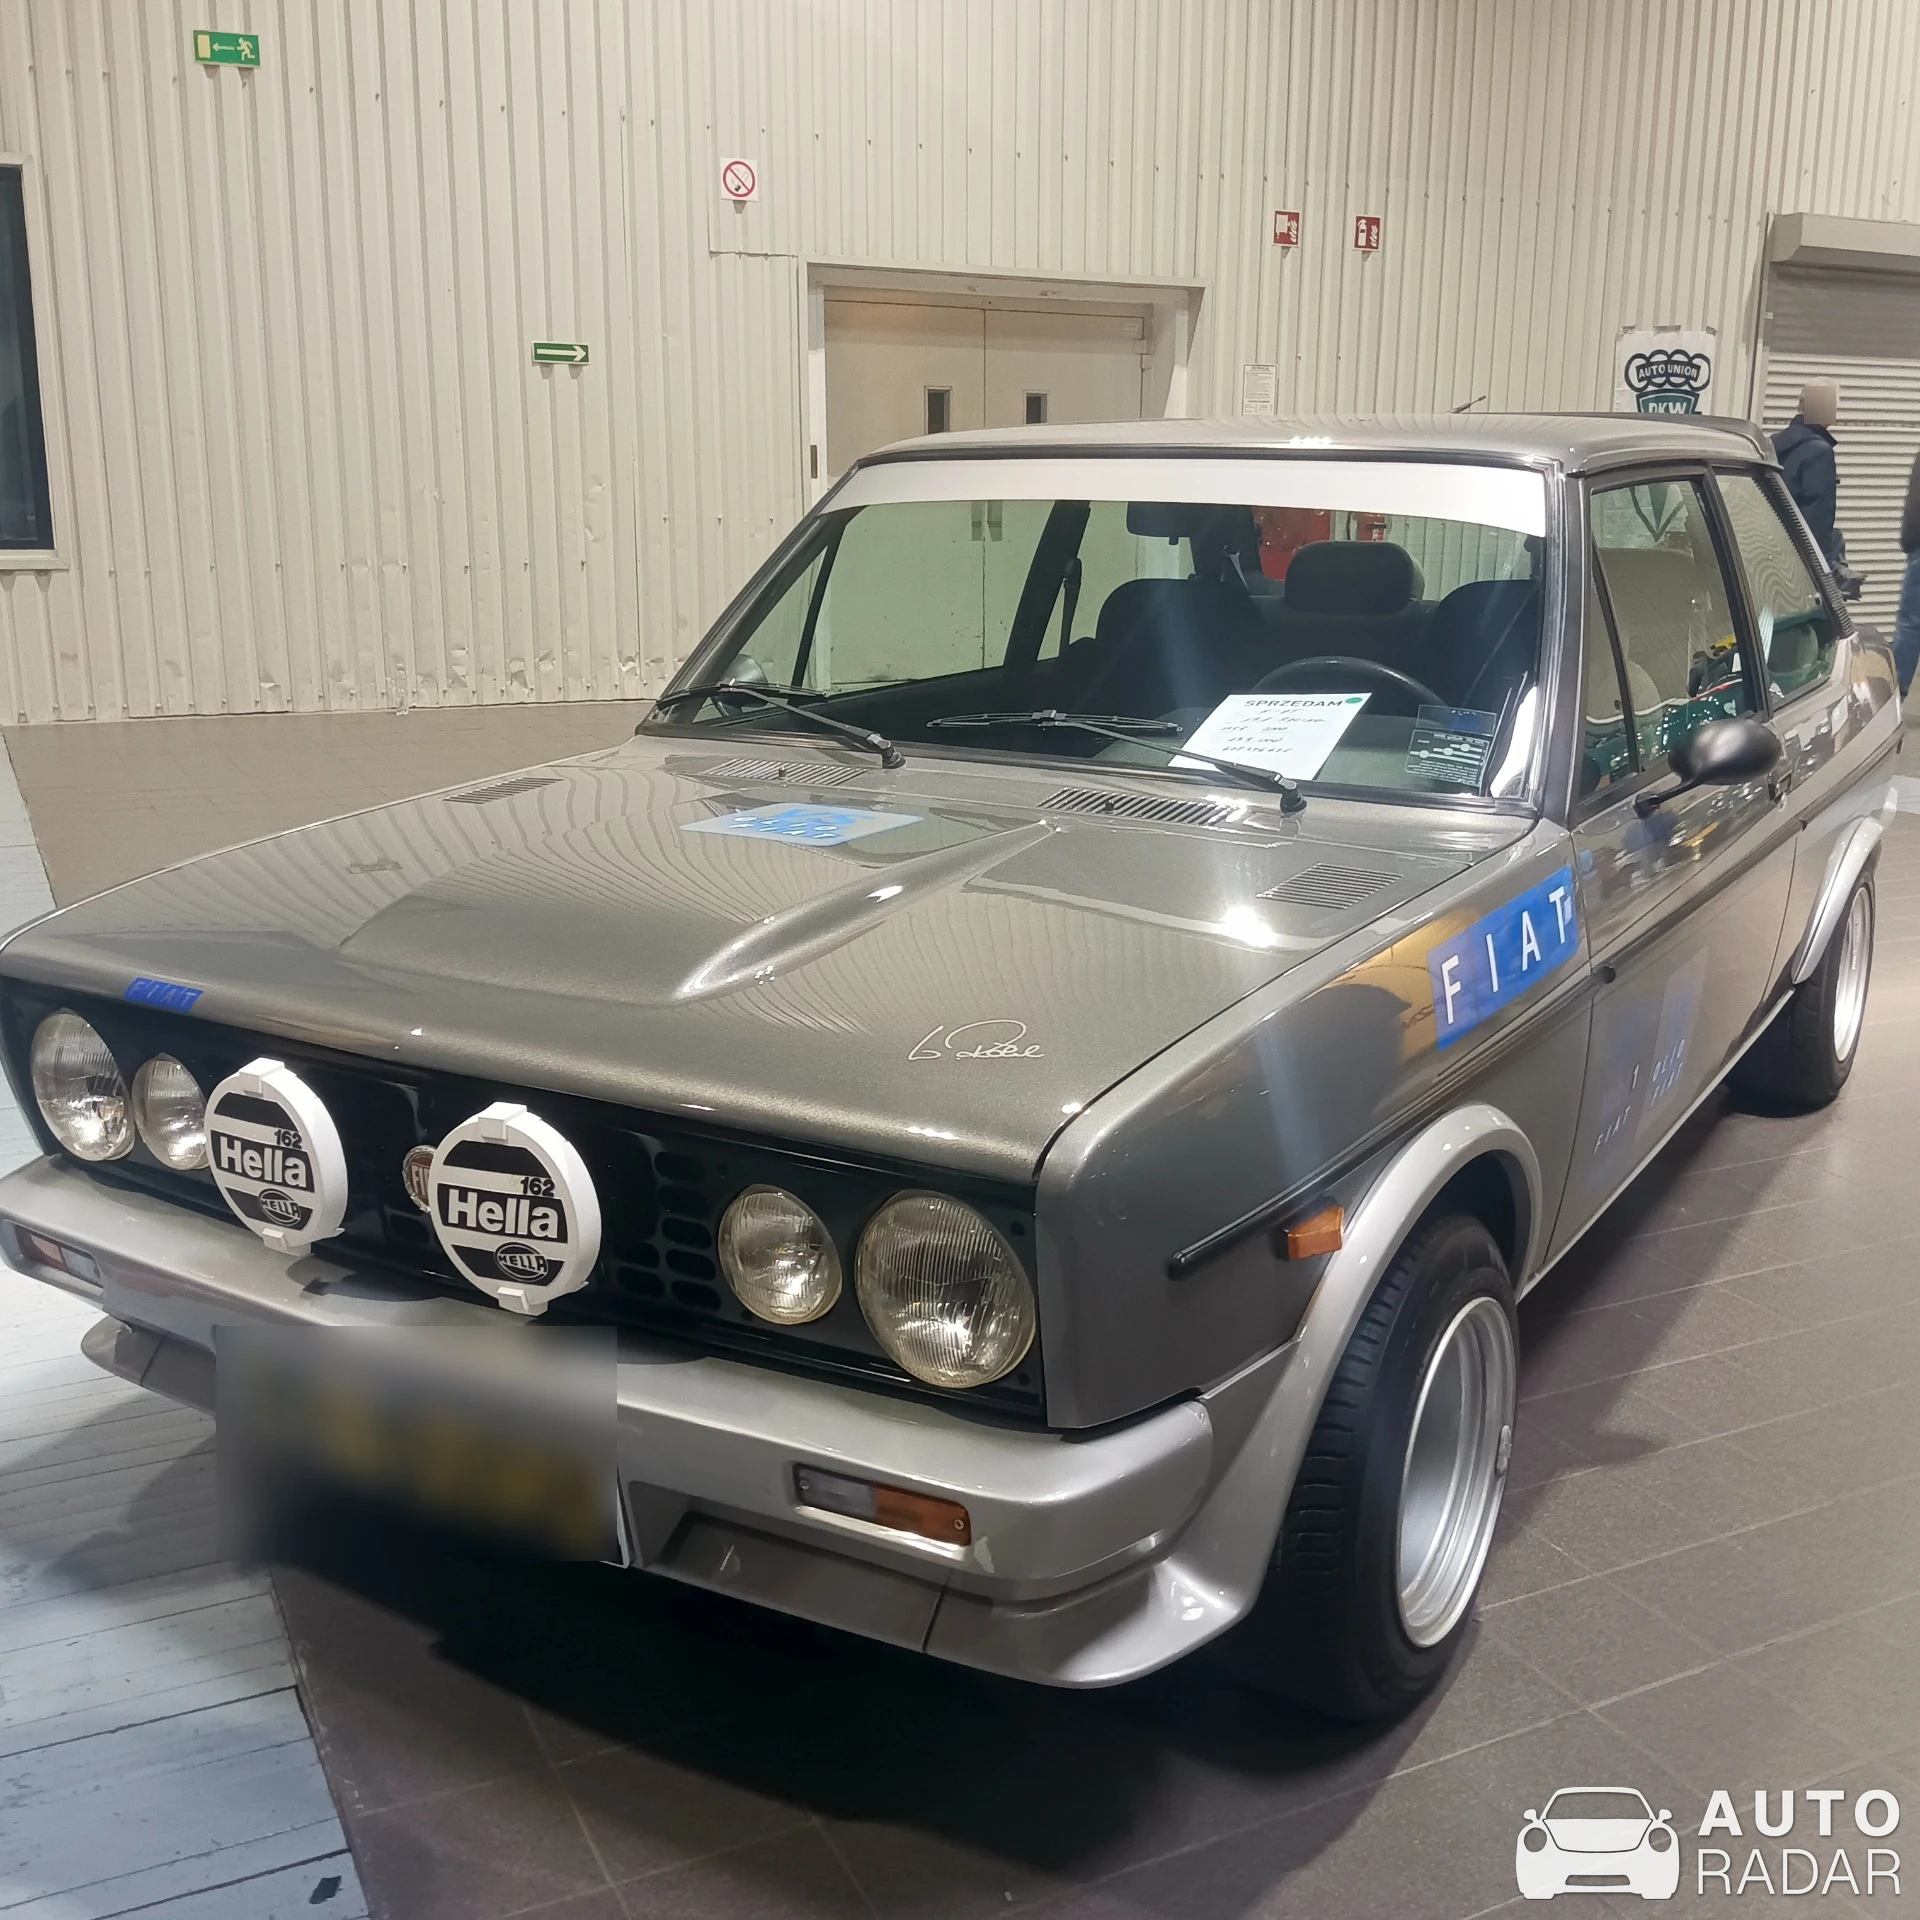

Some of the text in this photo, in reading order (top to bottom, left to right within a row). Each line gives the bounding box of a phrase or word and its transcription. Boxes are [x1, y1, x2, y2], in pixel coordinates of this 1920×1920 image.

[1638, 364, 1698, 379] AUTO UNION
[1648, 402, 1687, 414] DKW
[1441, 886, 1566, 1025] FIAT
[129, 981, 197, 1008] FIAT
[274, 1129, 303, 1149] 162
[1593, 1106, 1631, 1154] FIAT
[220, 1135, 307, 1188] Hella
[521, 1177, 555, 1197] 162
[261, 1200, 300, 1218] HELLA
[447, 1189, 558, 1239] Hella
[498, 1255, 547, 1274] HELLA
